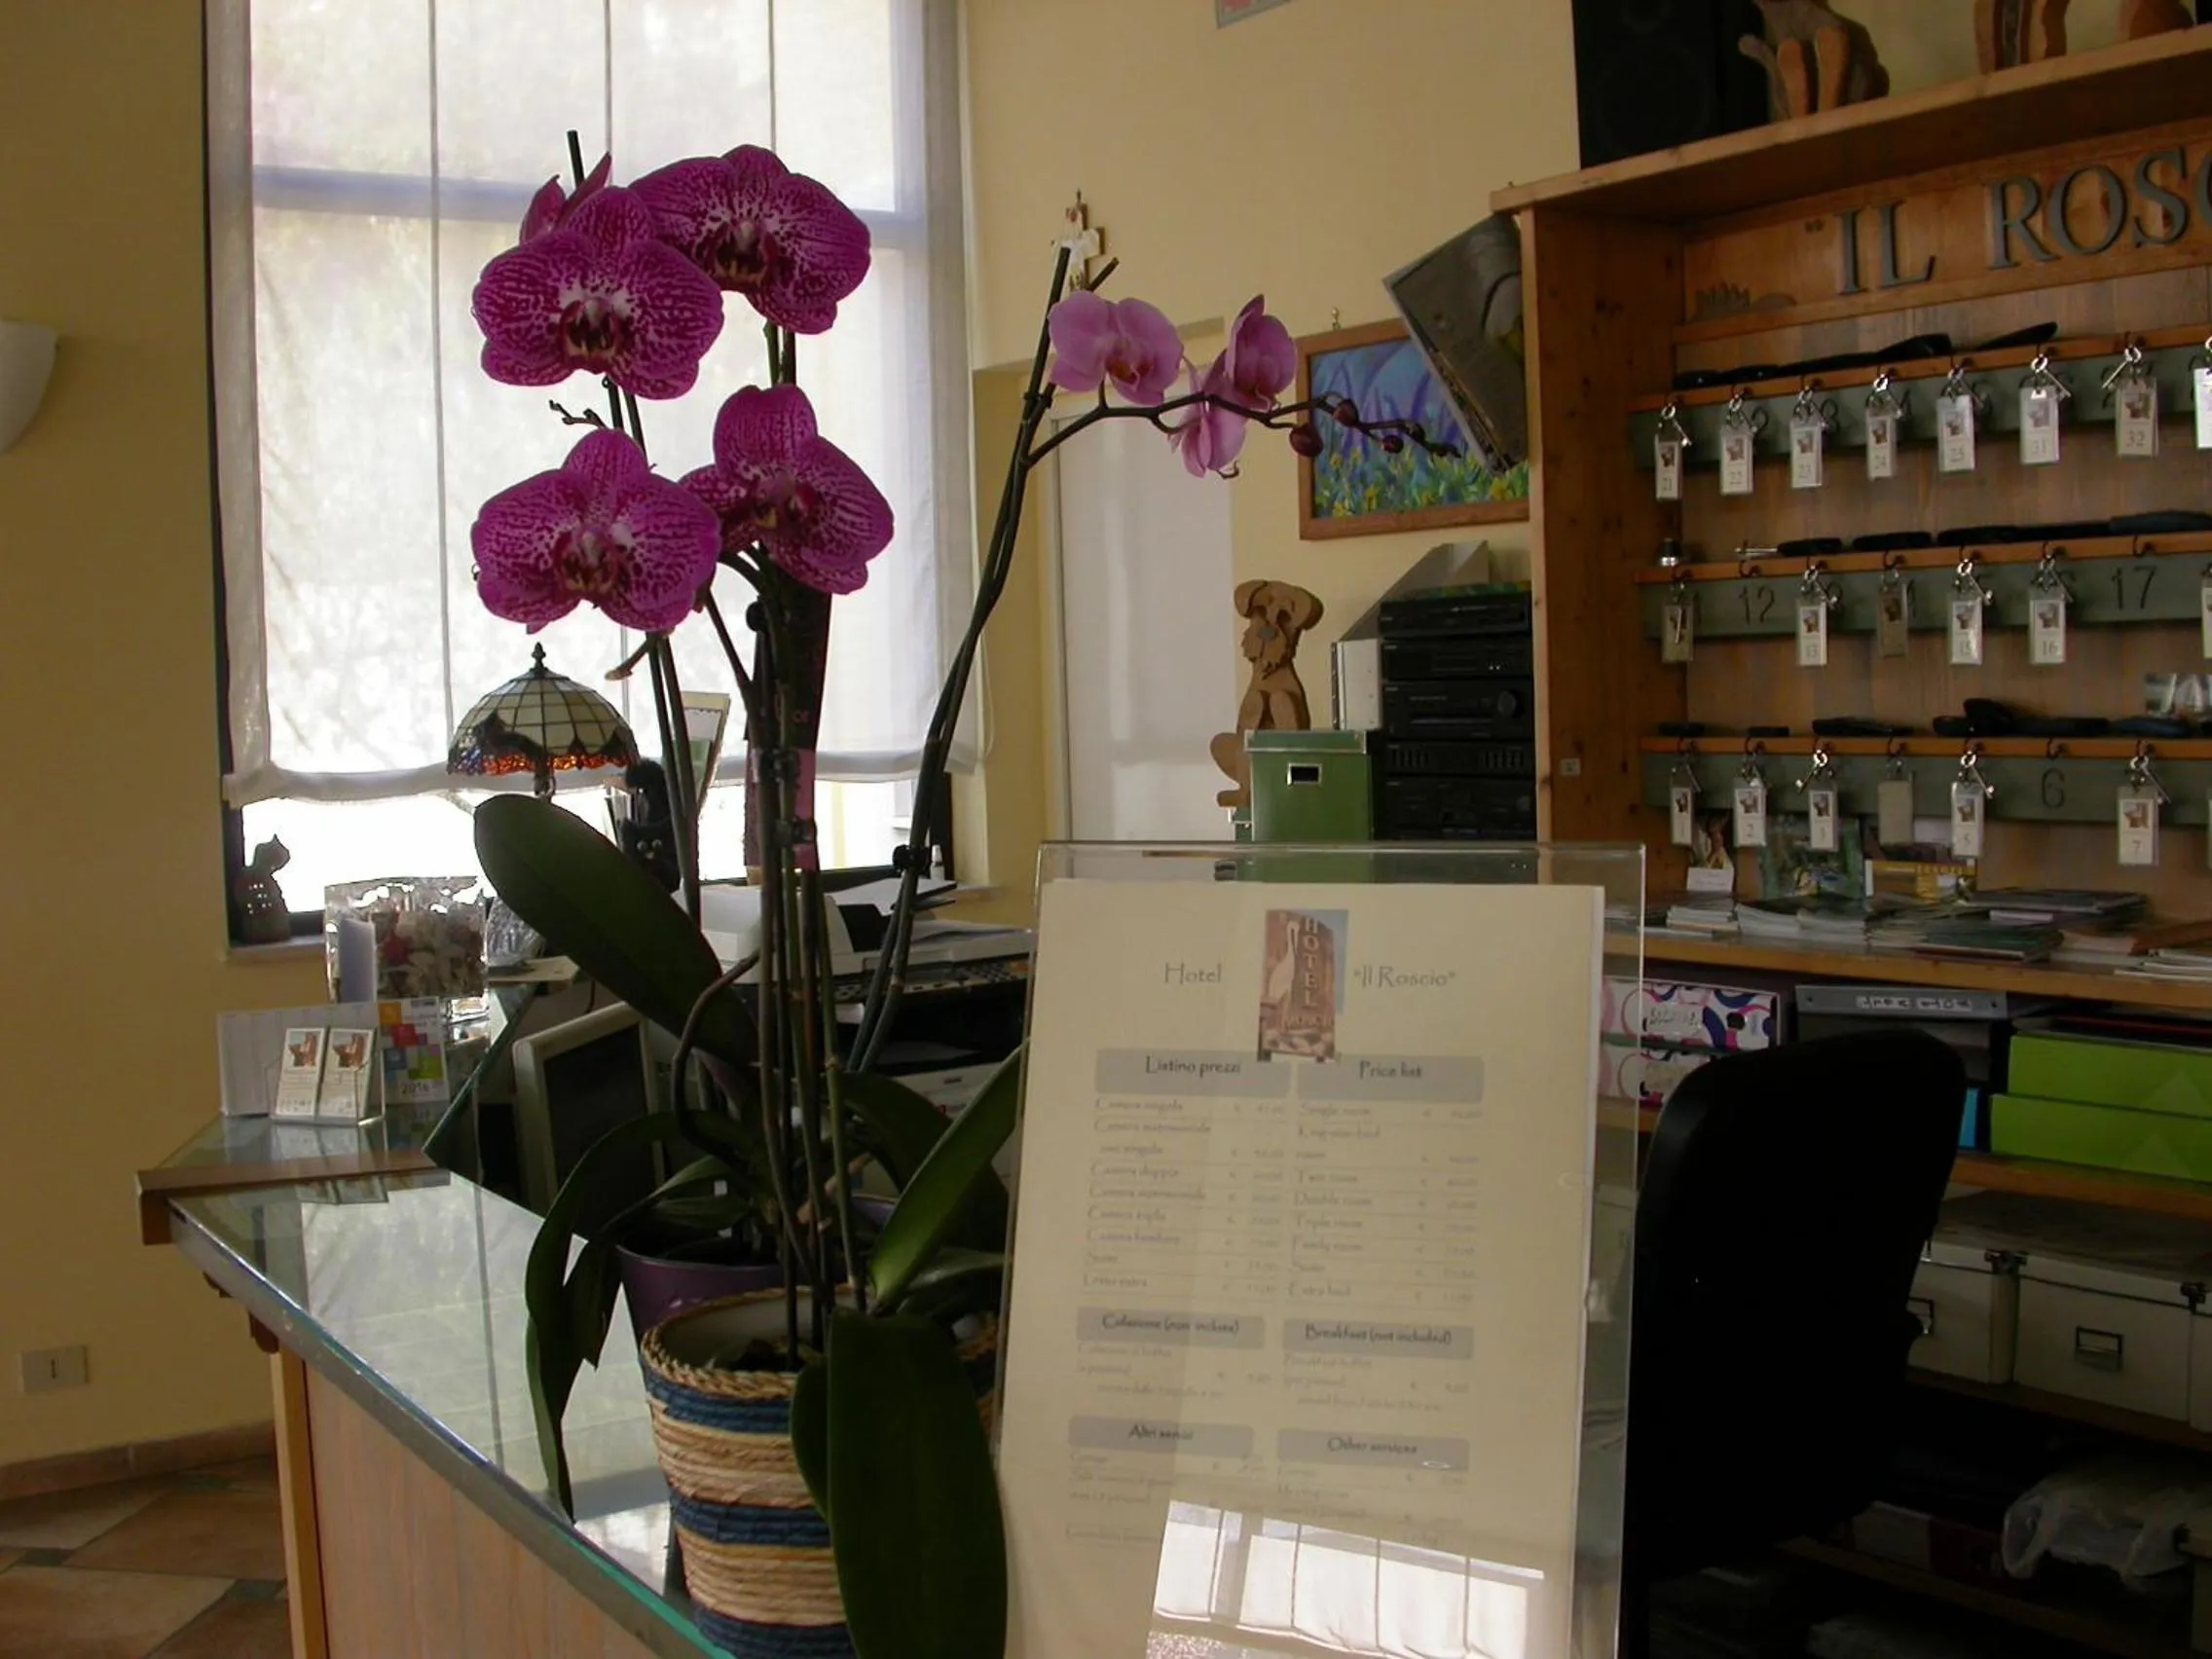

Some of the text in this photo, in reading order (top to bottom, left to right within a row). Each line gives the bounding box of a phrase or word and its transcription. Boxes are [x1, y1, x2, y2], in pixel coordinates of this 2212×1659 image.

[1835, 145, 2212, 295] IL ROS
[2111, 565, 2157, 611] 17
[1739, 586, 1775, 625] 12
[2041, 767, 2066, 809] 6
[1163, 963, 1223, 985] Hotel
[1302, 917, 1320, 1007] HOTEL
[1145, 1055, 1197, 1074] Listino
[1359, 1060, 1423, 1080] Price list
[1305, 1322, 1367, 1342] Breakfast
[1327, 1436, 1367, 1454] Other
